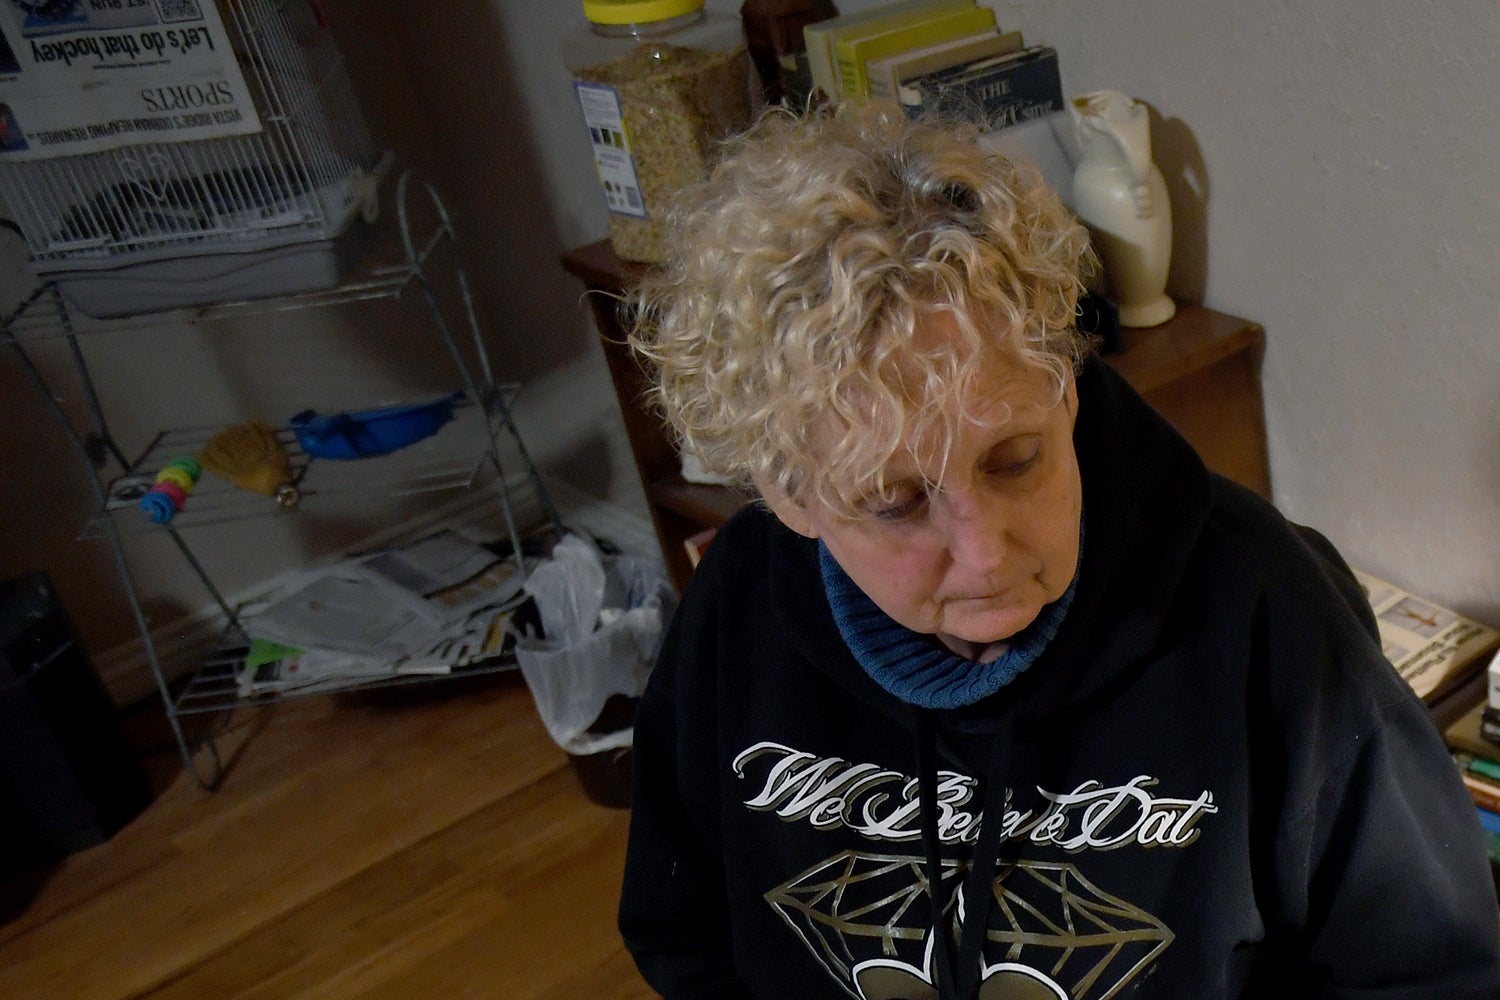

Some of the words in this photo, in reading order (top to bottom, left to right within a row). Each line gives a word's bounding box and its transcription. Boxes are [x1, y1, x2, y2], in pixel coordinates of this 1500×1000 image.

[30, 37, 104, 67] hockey
[100, 34, 141, 60] that
[141, 31, 166, 58] do
[169, 26, 216, 54] Let's
[140, 79, 235, 113] SPORTS
[214, 108, 243, 125] VISTA
[732, 741, 884, 831] We
[841, 769, 1070, 848] Beeve
[1036, 774, 1219, 850] Dat
